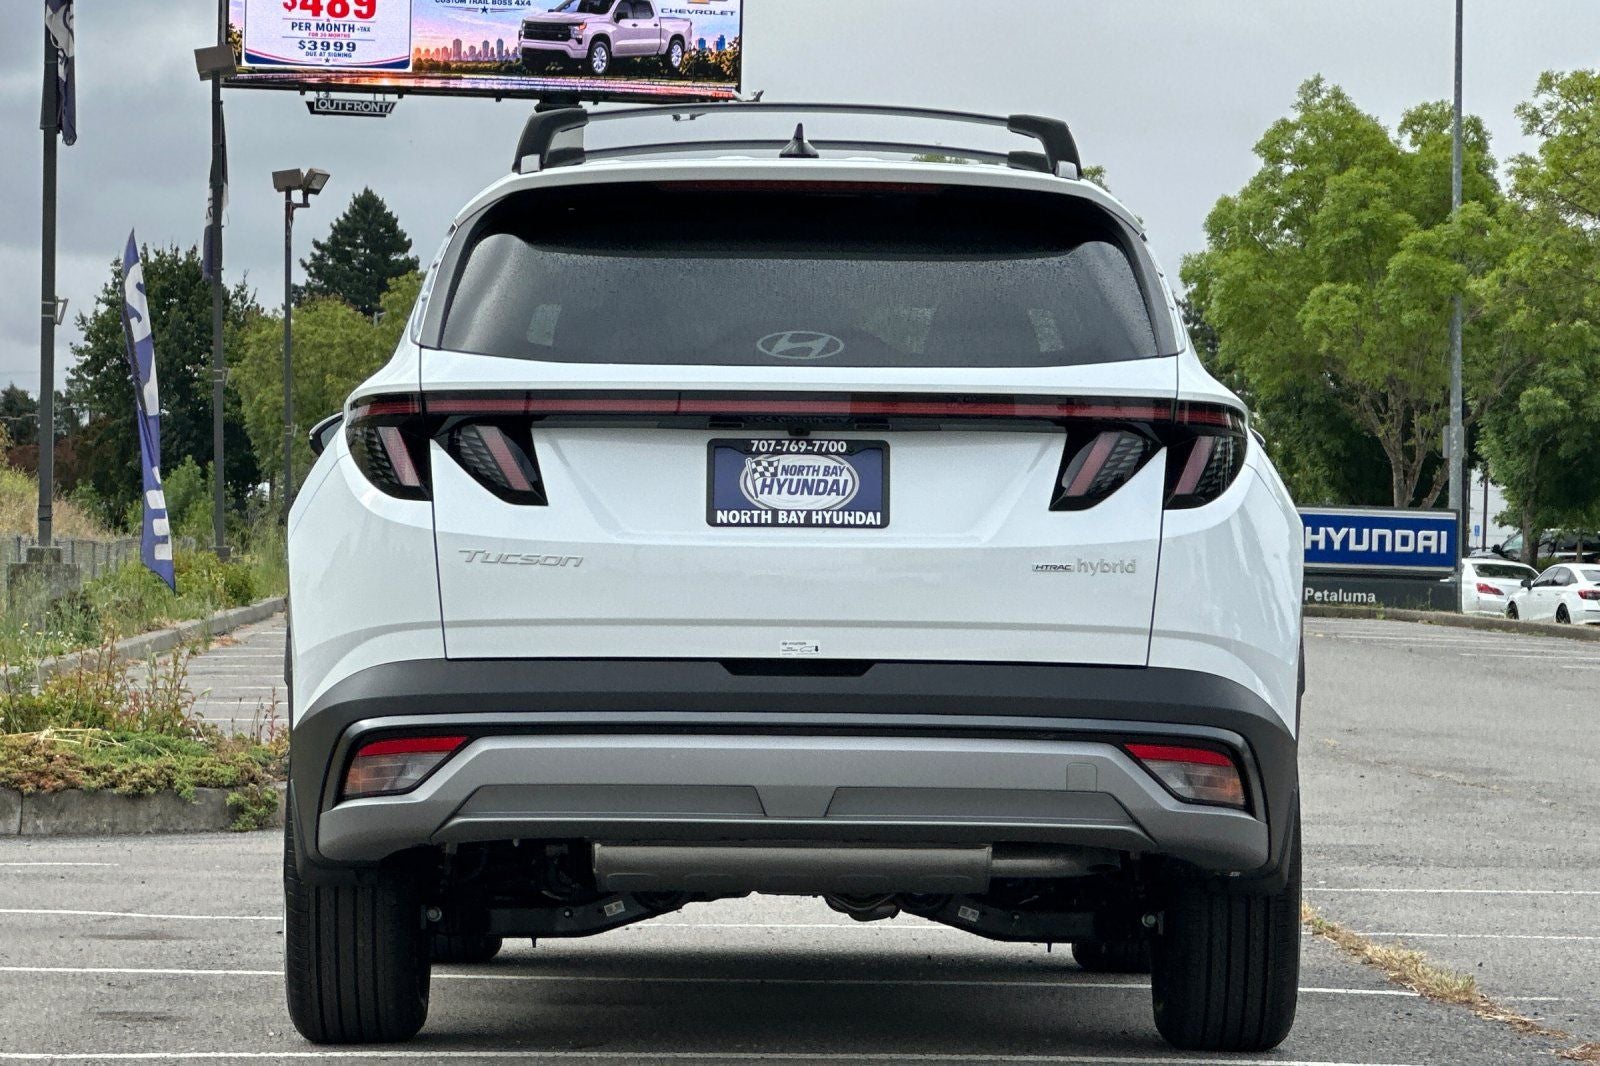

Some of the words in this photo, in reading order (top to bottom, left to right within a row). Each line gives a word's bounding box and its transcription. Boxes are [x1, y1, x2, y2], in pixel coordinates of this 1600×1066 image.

[660, 8, 736, 16] CHEVROLET
[291, 22, 311, 31] PER
[315, 22, 355, 33] MONTH
[298, 40, 357, 53] $3999
[751, 440, 847, 454] 707-769-7700
[781, 465, 819, 477] NORTH
[822, 465, 846, 477] BAY
[760, 478, 849, 496] HYUNDAI
[716, 510, 772, 525] NORTH
[778, 510, 807, 525] BAY
[812, 511, 882, 526] HYUNDAI
[1304, 526, 1448, 554] HYUNDAI
[1035, 564, 1071, 572] HTRAC
[1077, 558, 1136, 576] hybrid
[1305, 588, 1376, 602] Petaluma
